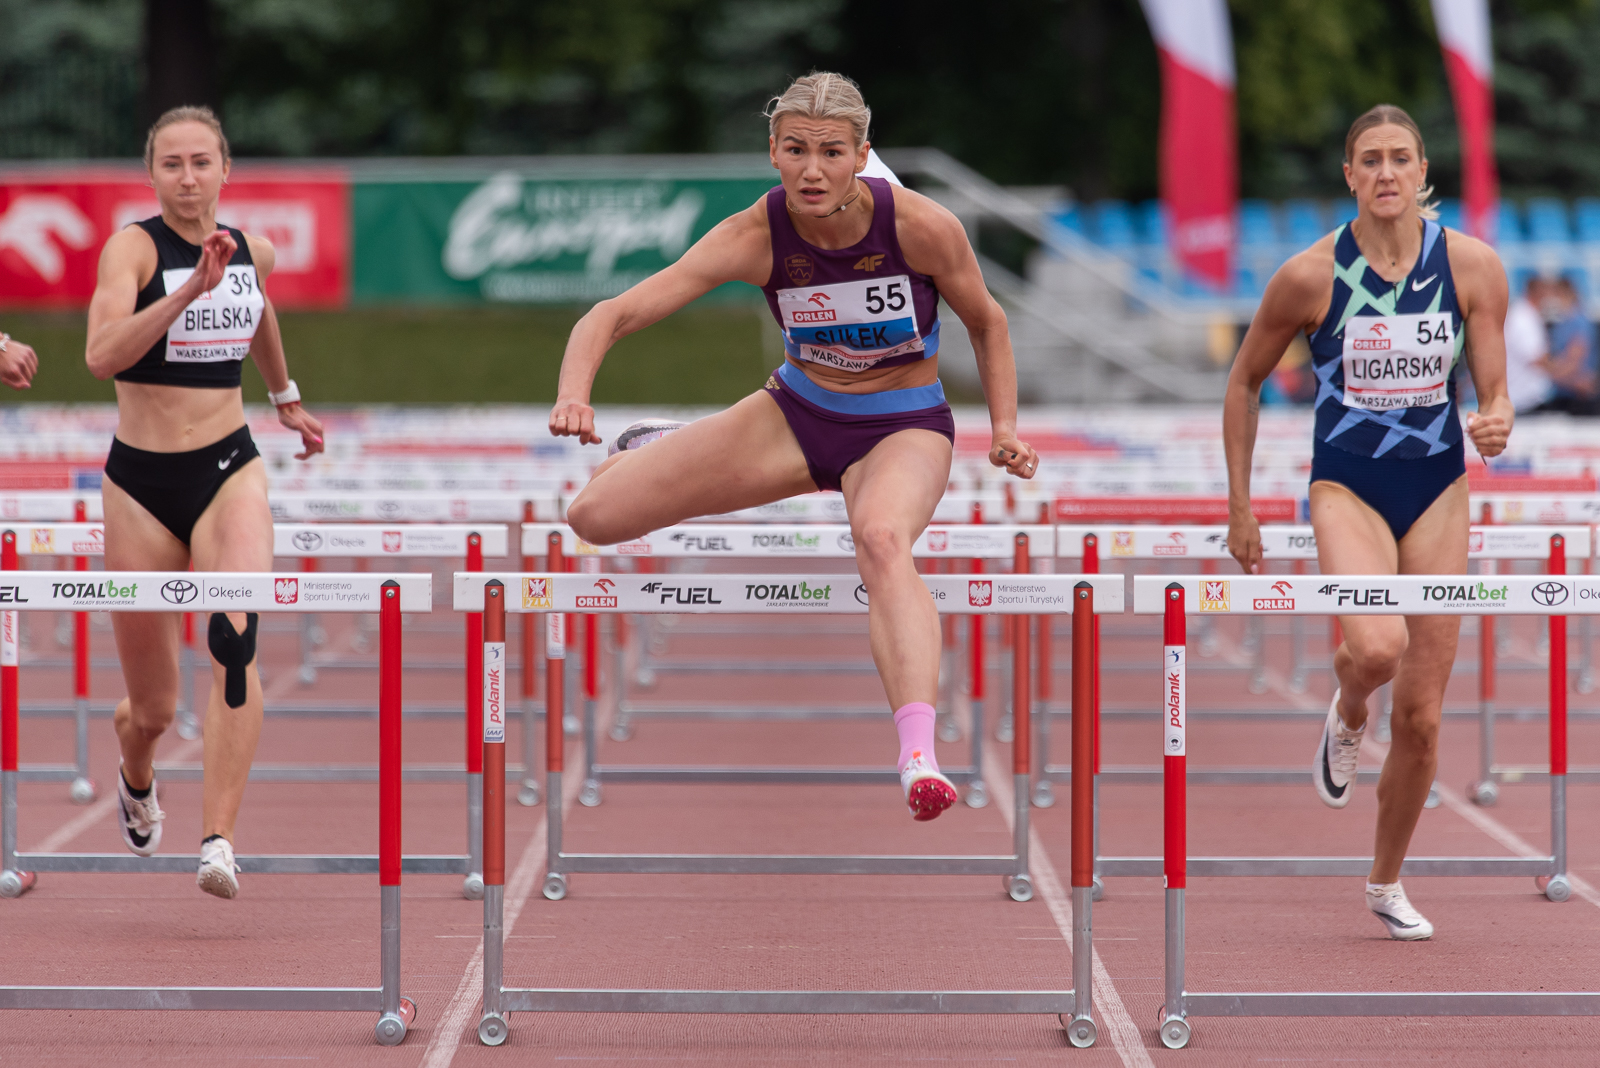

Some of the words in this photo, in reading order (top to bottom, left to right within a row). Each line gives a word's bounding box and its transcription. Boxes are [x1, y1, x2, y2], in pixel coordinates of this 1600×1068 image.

[853, 254, 885, 271] 4F
[229, 273, 252, 295] 39
[866, 283, 906, 314] 55
[185, 307, 253, 331] BIELSKA
[794, 311, 834, 323] ORLEN
[1416, 320, 1449, 345] 54
[175, 347, 228, 359] WARSZAWA
[1354, 340, 1390, 350] ORLEN
[810, 347, 871, 369] WARSZAWA
[1352, 356, 1442, 380] LIGARSKA
[1353, 395, 1409, 407] WARSZAWA
[1411, 394, 1433, 407] 2022
[0, 586, 29, 603] EL
[52, 580, 138, 598] TOTALbet
[208, 586, 253, 600] Okęcie
[304, 582, 352, 590] Ministerstwo
[640, 582, 662, 594] 4F
[660, 588, 722, 605] FUEL
[745, 581, 831, 600] TOTALbet
[997, 584, 1046, 593] Ministerstwo
[1422, 582, 1509, 601] TOTALbet
[304, 593, 329, 602] Sportu
[335, 593, 370, 602] Turystyki
[524, 598, 551, 608] PZLA
[577, 597, 616, 607] ORLEN
[997, 596, 1023, 605] Sportu
[1029, 595, 1064, 605] Turystyki
[1318, 584, 1340, 595] 4F
[1337, 589, 1399, 606] FUEL
[1201, 602, 1228, 611] PZLA
[1255, 600, 1293, 609] ORLEN
[488, 669, 502, 724] polanik
[1168, 672, 1182, 729] polanik
